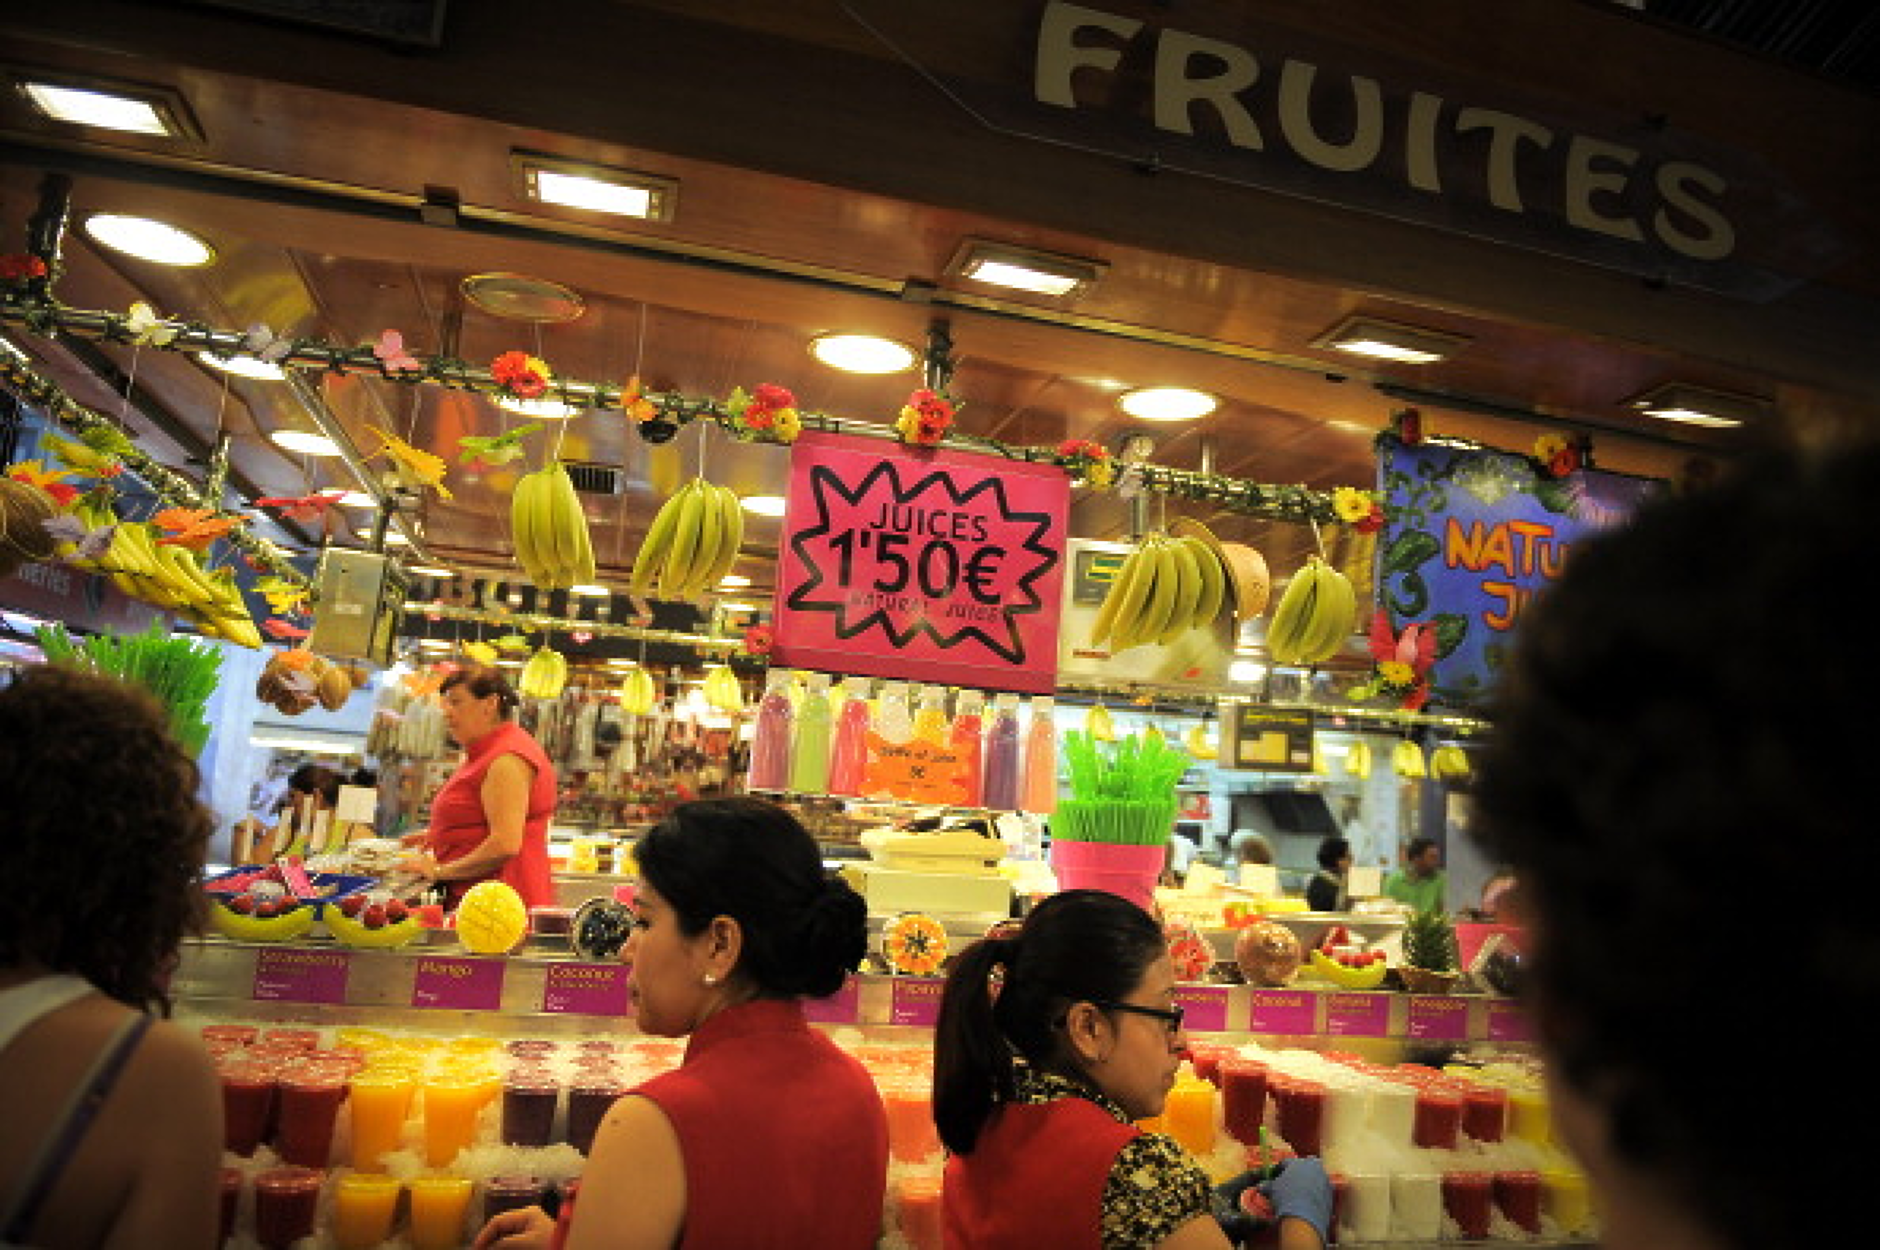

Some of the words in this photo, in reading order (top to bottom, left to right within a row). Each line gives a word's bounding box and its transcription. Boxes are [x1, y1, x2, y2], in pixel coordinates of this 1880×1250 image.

[1034, 0, 1736, 261] FRUITES
[870, 503, 988, 541] JUICES
[829, 528, 1007, 602] 1'50€
[420, 961, 473, 978] Mango
